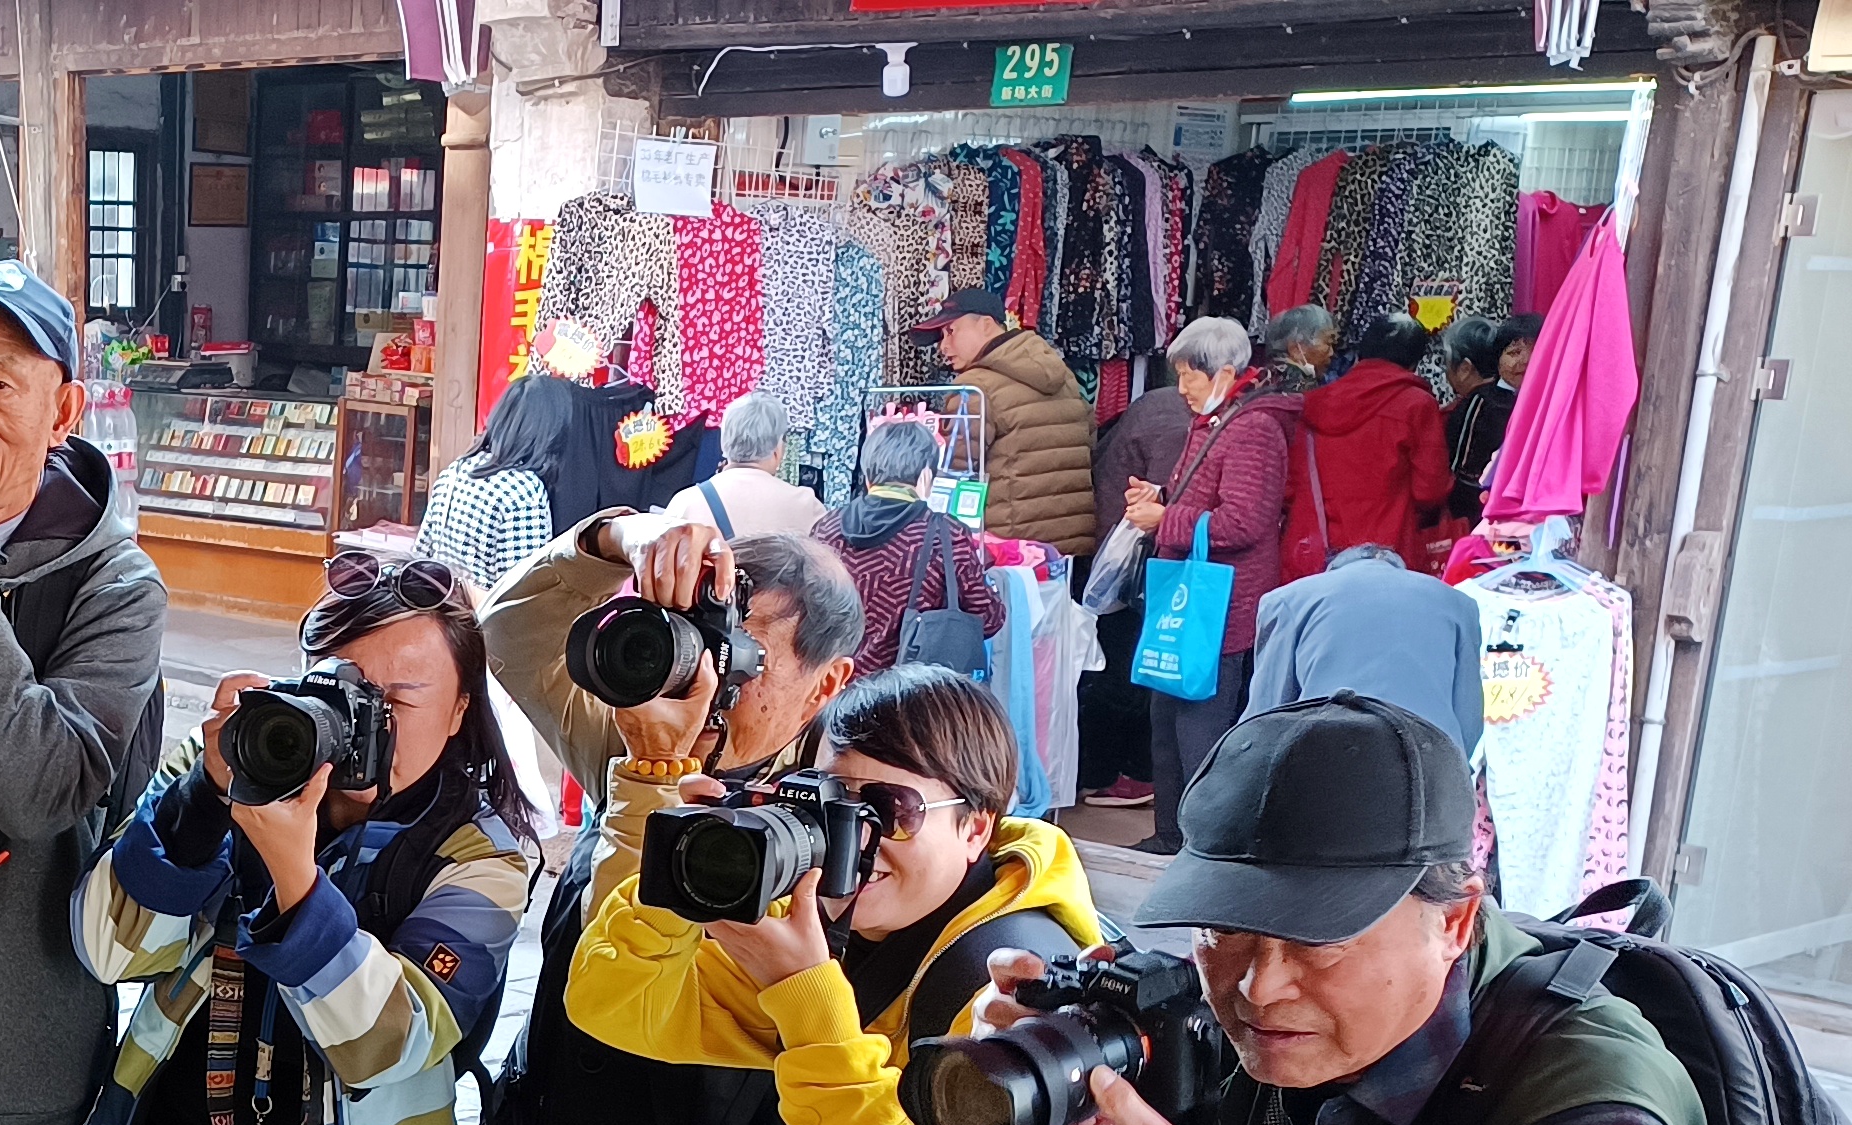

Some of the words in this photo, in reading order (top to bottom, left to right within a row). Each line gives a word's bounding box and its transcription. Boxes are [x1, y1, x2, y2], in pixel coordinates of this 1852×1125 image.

[1003, 43, 1060, 79] 295
[718, 641, 731, 675] Nikon
[306, 674, 337, 687] Nikon
[779, 787, 818, 803] LEICA
[1100, 975, 1132, 995] SONY
